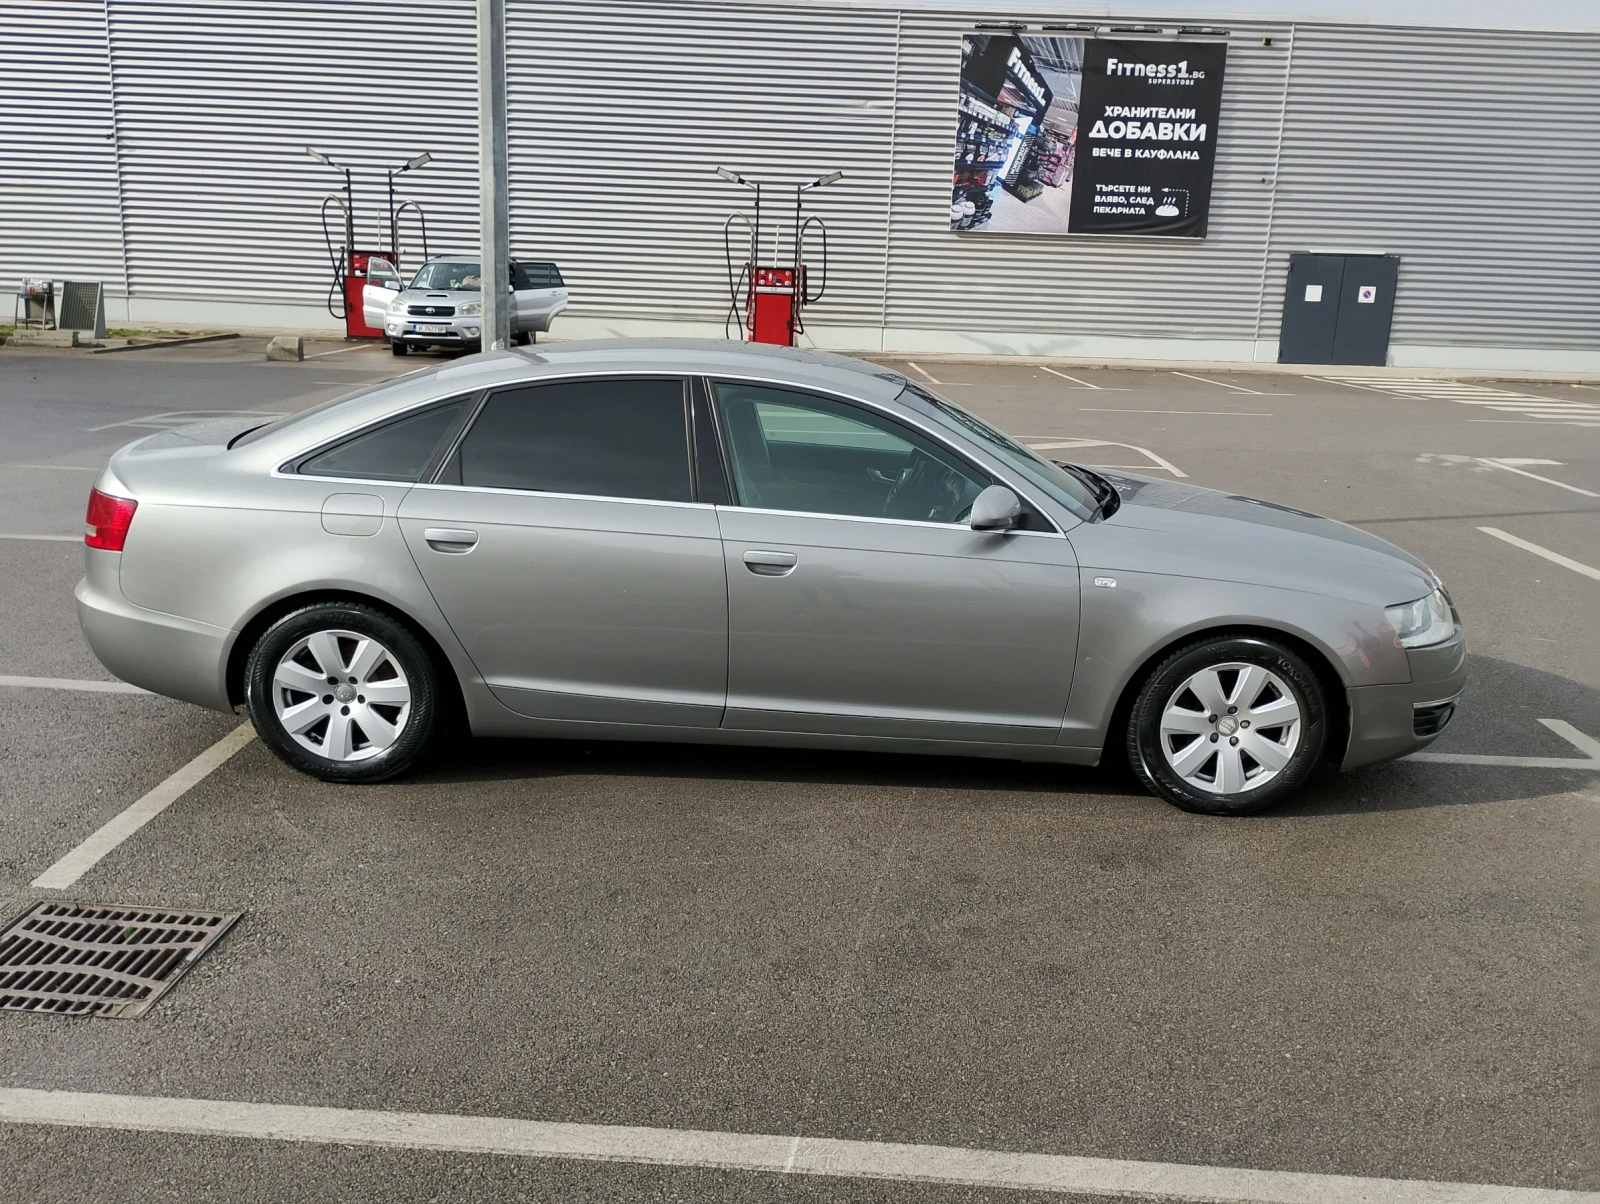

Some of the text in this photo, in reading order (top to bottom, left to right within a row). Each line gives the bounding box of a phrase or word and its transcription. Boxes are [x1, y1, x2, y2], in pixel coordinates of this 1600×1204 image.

[1104, 105, 1196, 119] ХРАНИТЕЛНИ
[1088, 120, 1207, 141] ДОБАВКИ
[1092, 147, 1200, 160] ВЕЧЕ В КАУФЛАНД
[1095, 184, 1151, 193] ТЪРСЕТЕ НИ
[1094, 195, 1155, 205] ВЛЯВО, СЛЕД
[1093, 206, 1146, 215] ПЕКАРНАТА
